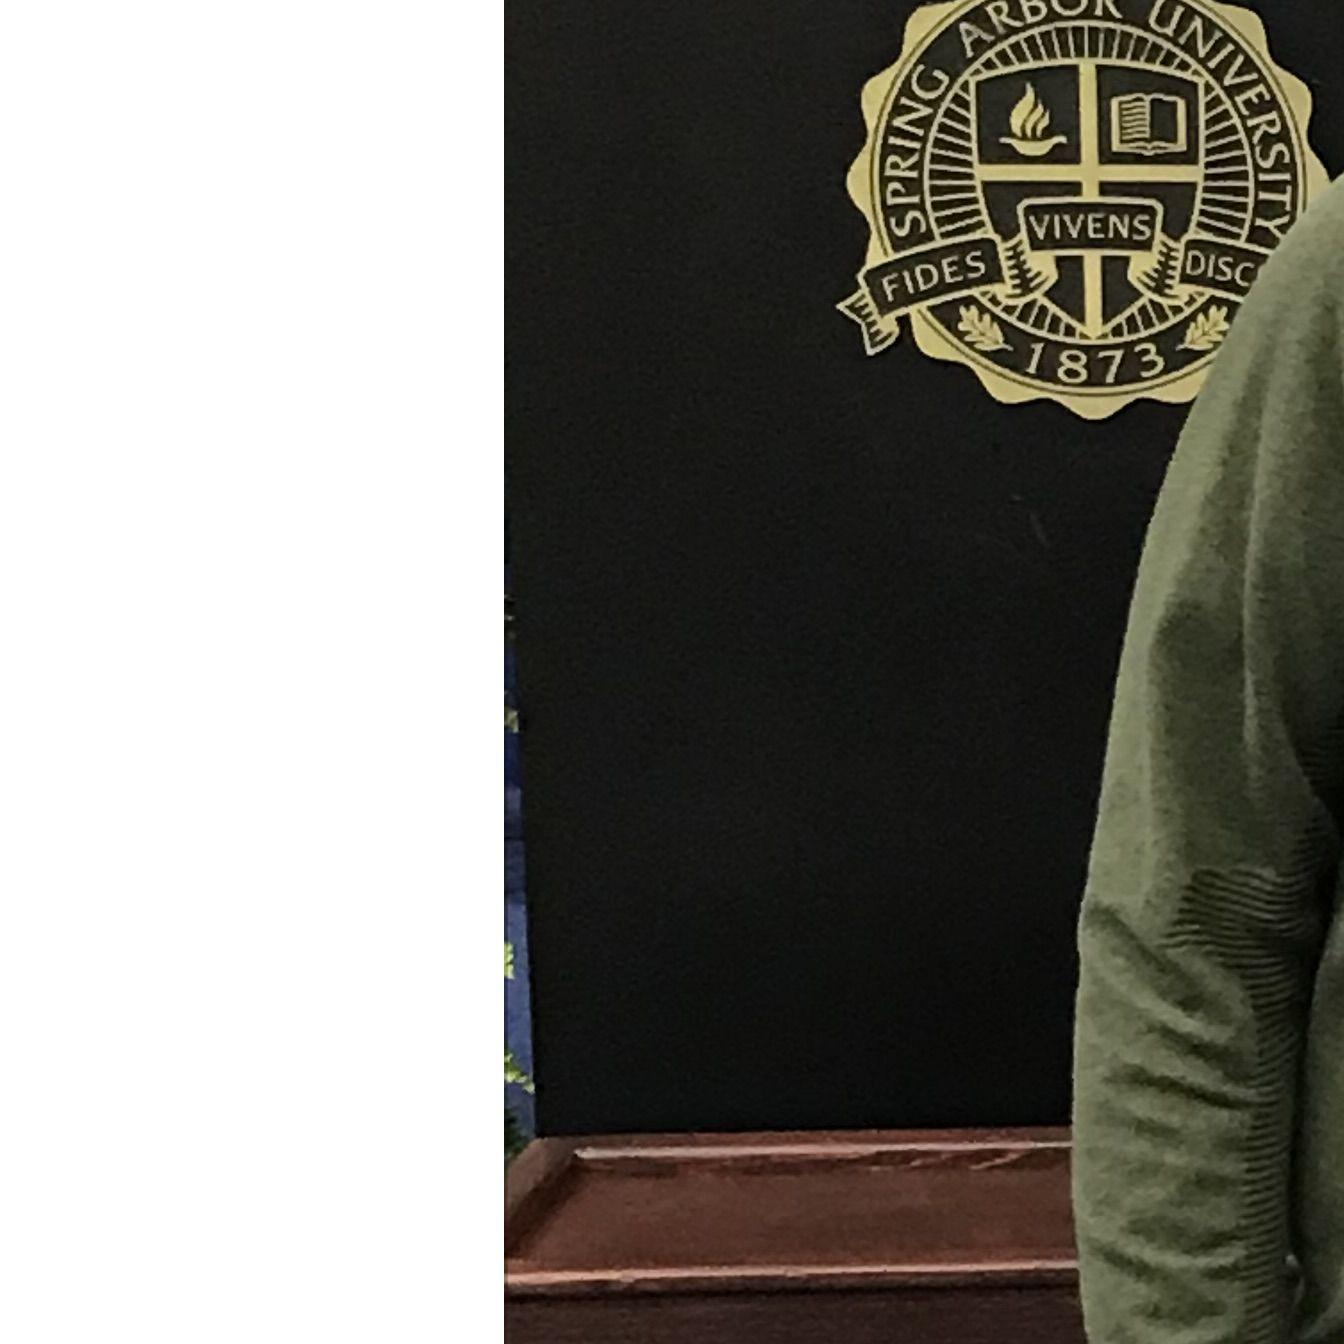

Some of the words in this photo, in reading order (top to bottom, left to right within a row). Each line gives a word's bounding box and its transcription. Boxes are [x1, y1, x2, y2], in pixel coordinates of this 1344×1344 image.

[884, 63, 951, 238] SPRING
[1148, 0, 1293, 239] UNIVERSITY
[881, 249, 987, 303] FIDES
[1028, 211, 1154, 242] VIVENS
[1025, 342, 1166, 385] 1873
